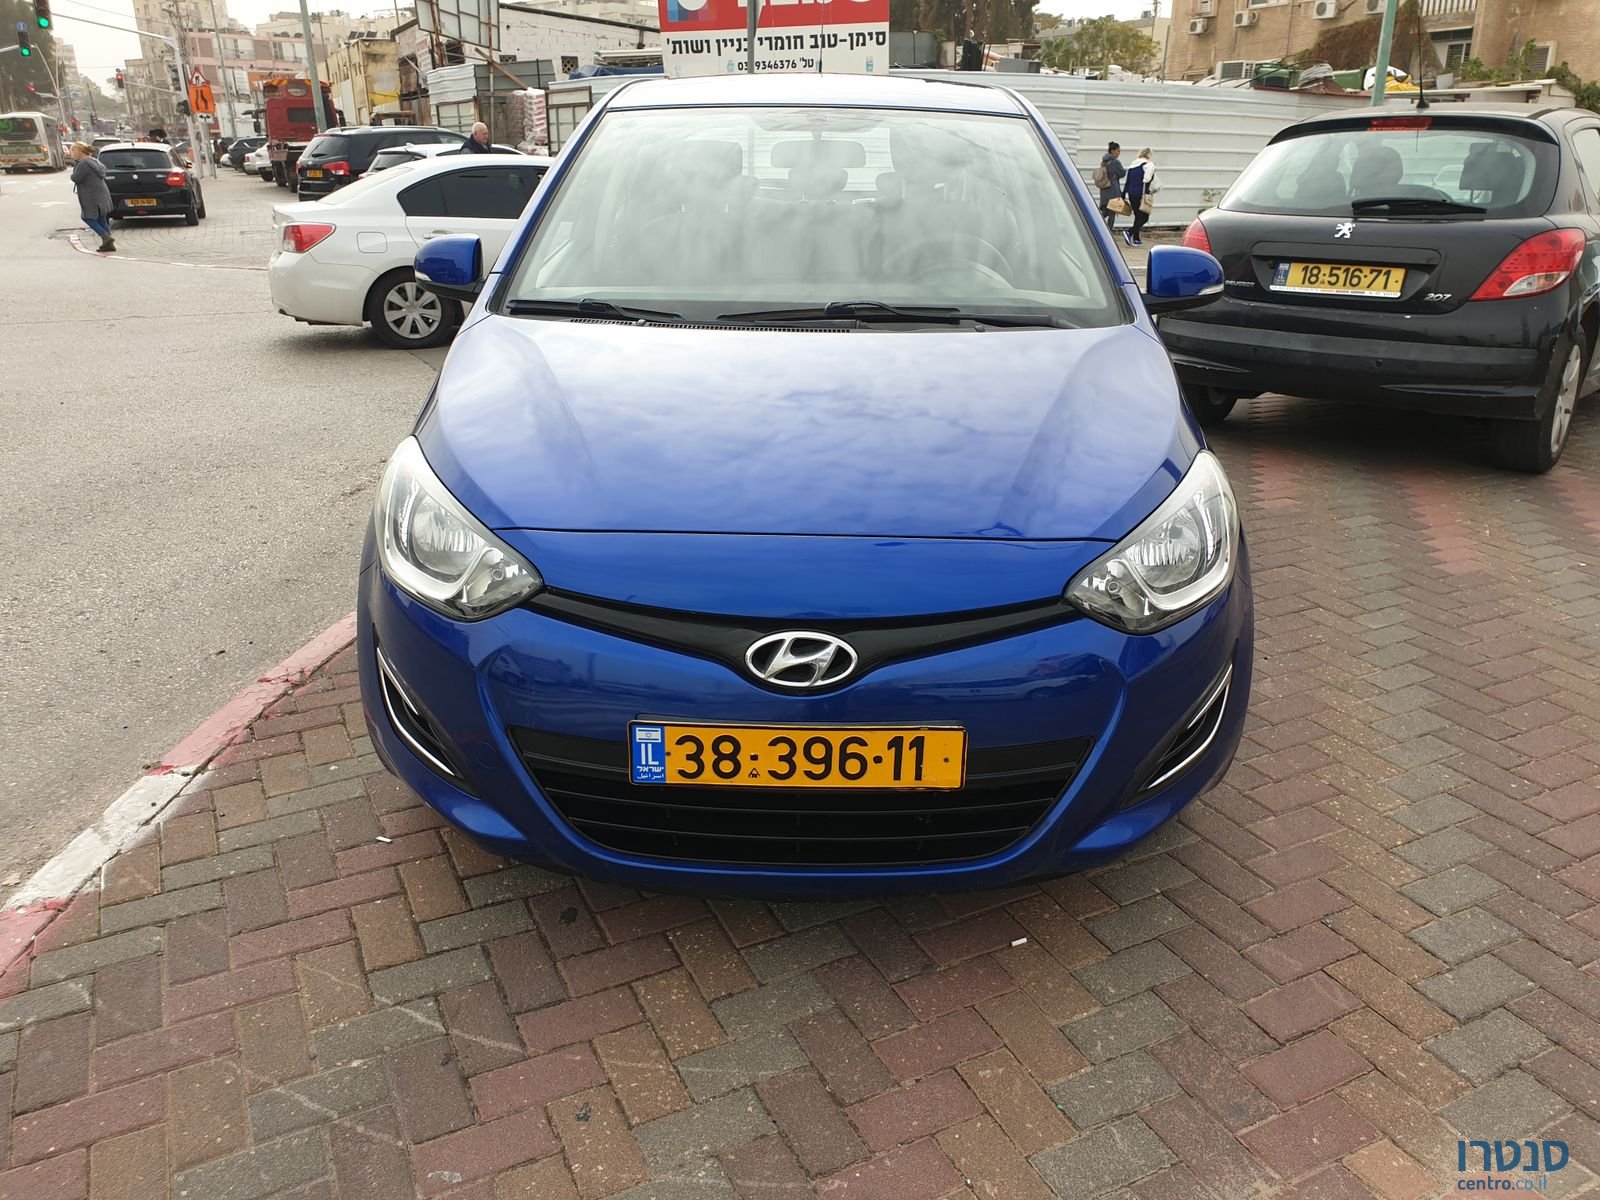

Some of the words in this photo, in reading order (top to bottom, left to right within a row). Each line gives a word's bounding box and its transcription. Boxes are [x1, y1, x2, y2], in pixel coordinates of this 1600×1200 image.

[757, 35, 804, 51] חומרי
[809, 31, 886, 50] סימן-טוב
[1424, 293, 1452, 301] 207
[640, 743, 659, 764] IL
